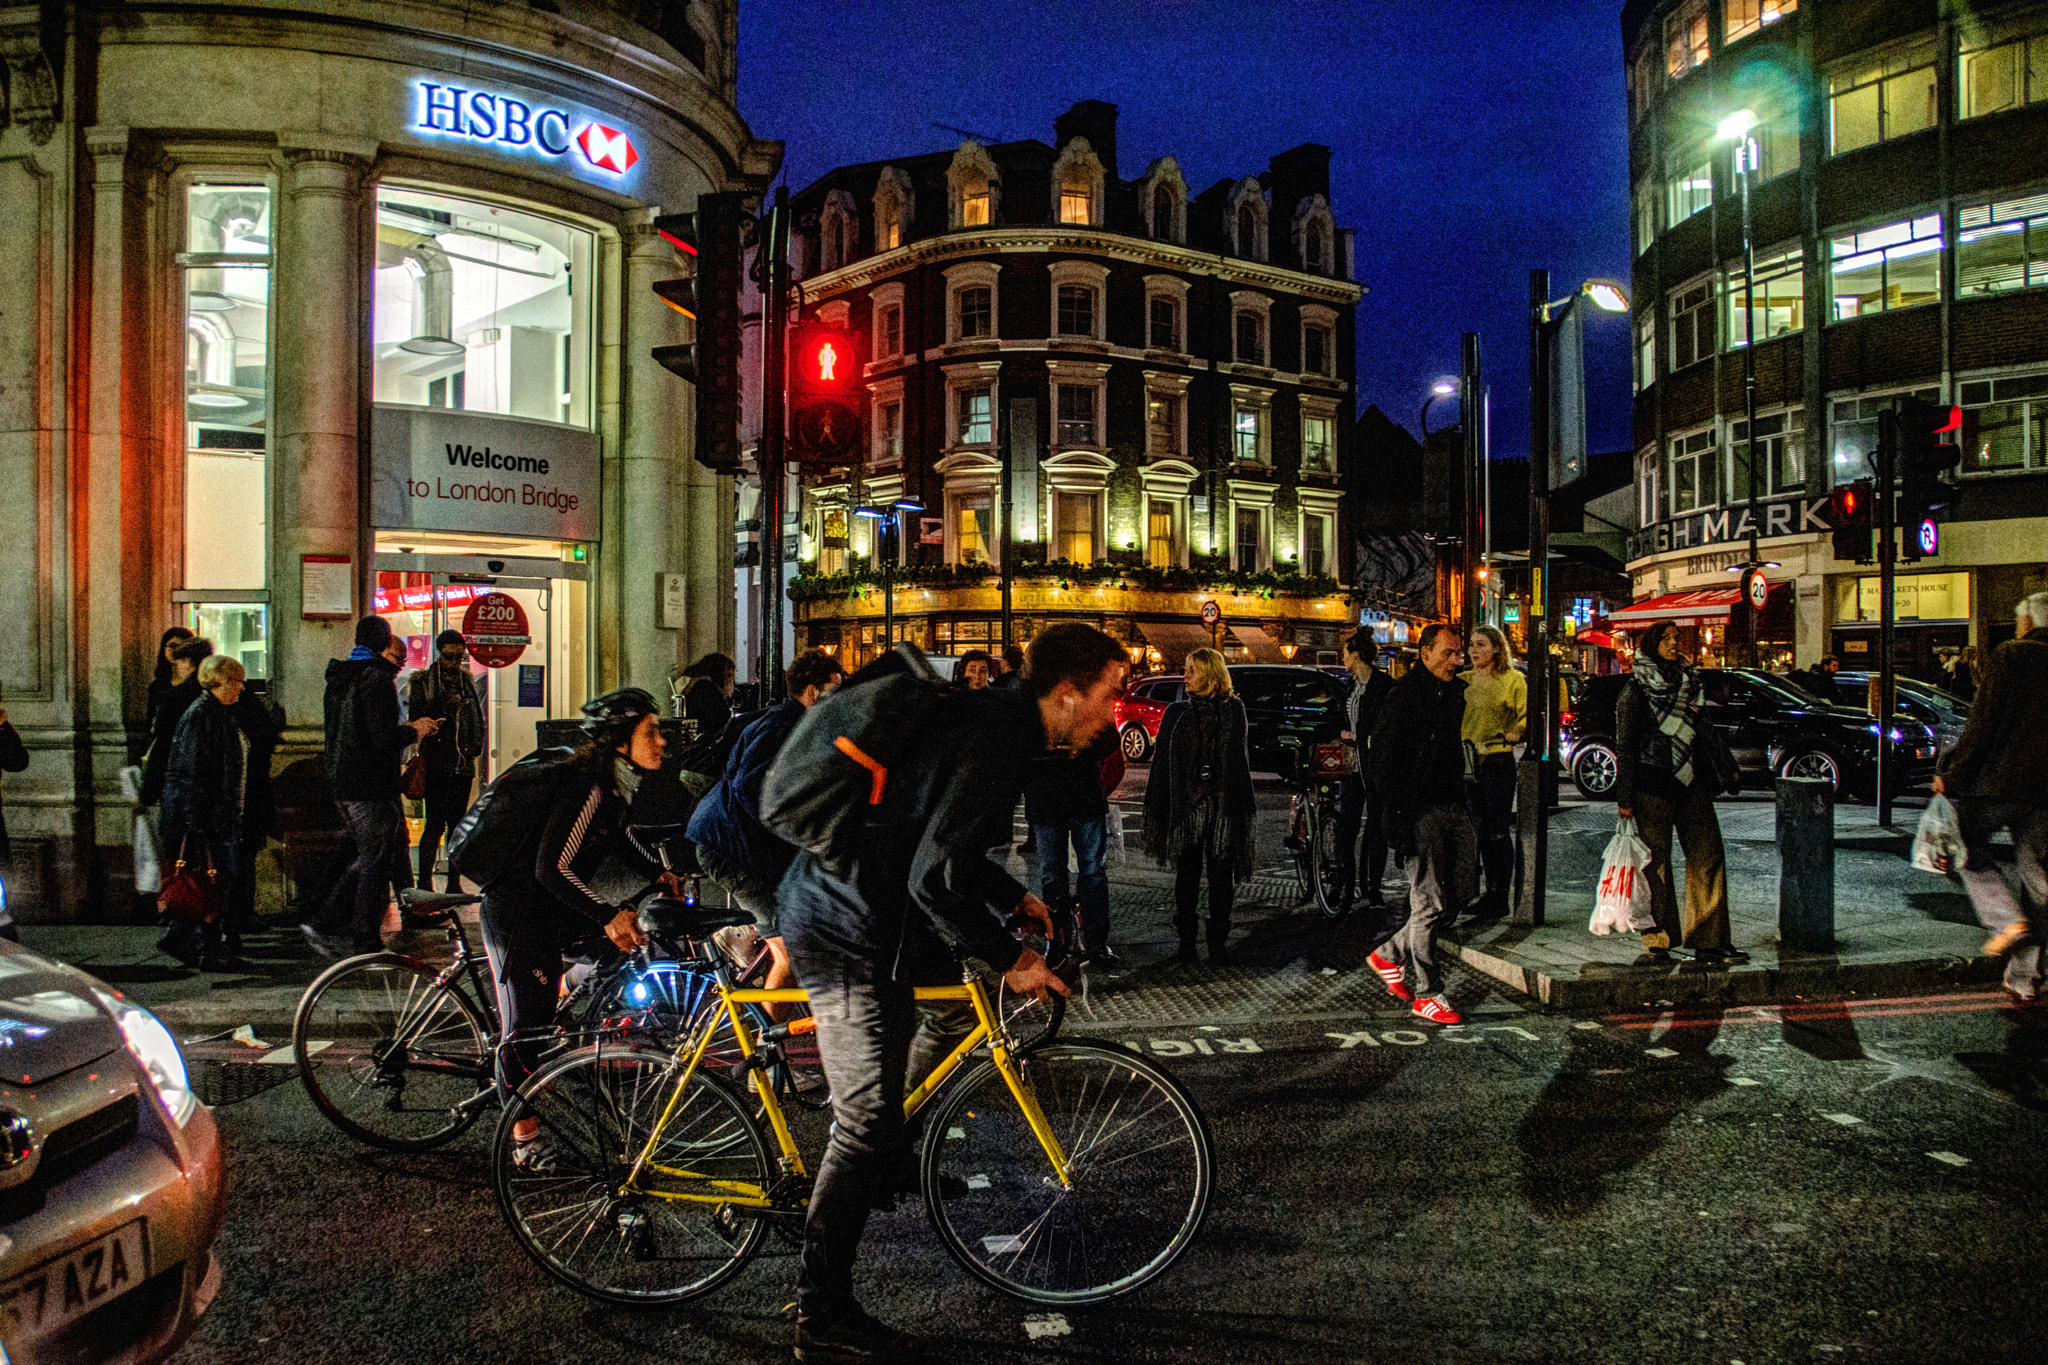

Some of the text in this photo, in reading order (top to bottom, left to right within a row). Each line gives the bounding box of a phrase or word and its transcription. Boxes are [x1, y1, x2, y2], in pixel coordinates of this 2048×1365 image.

[419, 82, 569, 155] HSBC
[446, 443, 549, 475] Welcome
[407, 477, 579, 514] to London Bridge
[1753, 583, 1765, 599] 20
[1920, 583, 1948, 592] HOUSE
[488, 595, 504, 605] Get
[477, 605, 515, 620] £200
[1204, 608, 1216, 617] 20
[479, 636, 495, 644] ends
[64, 1238, 129, 1313] AZA
